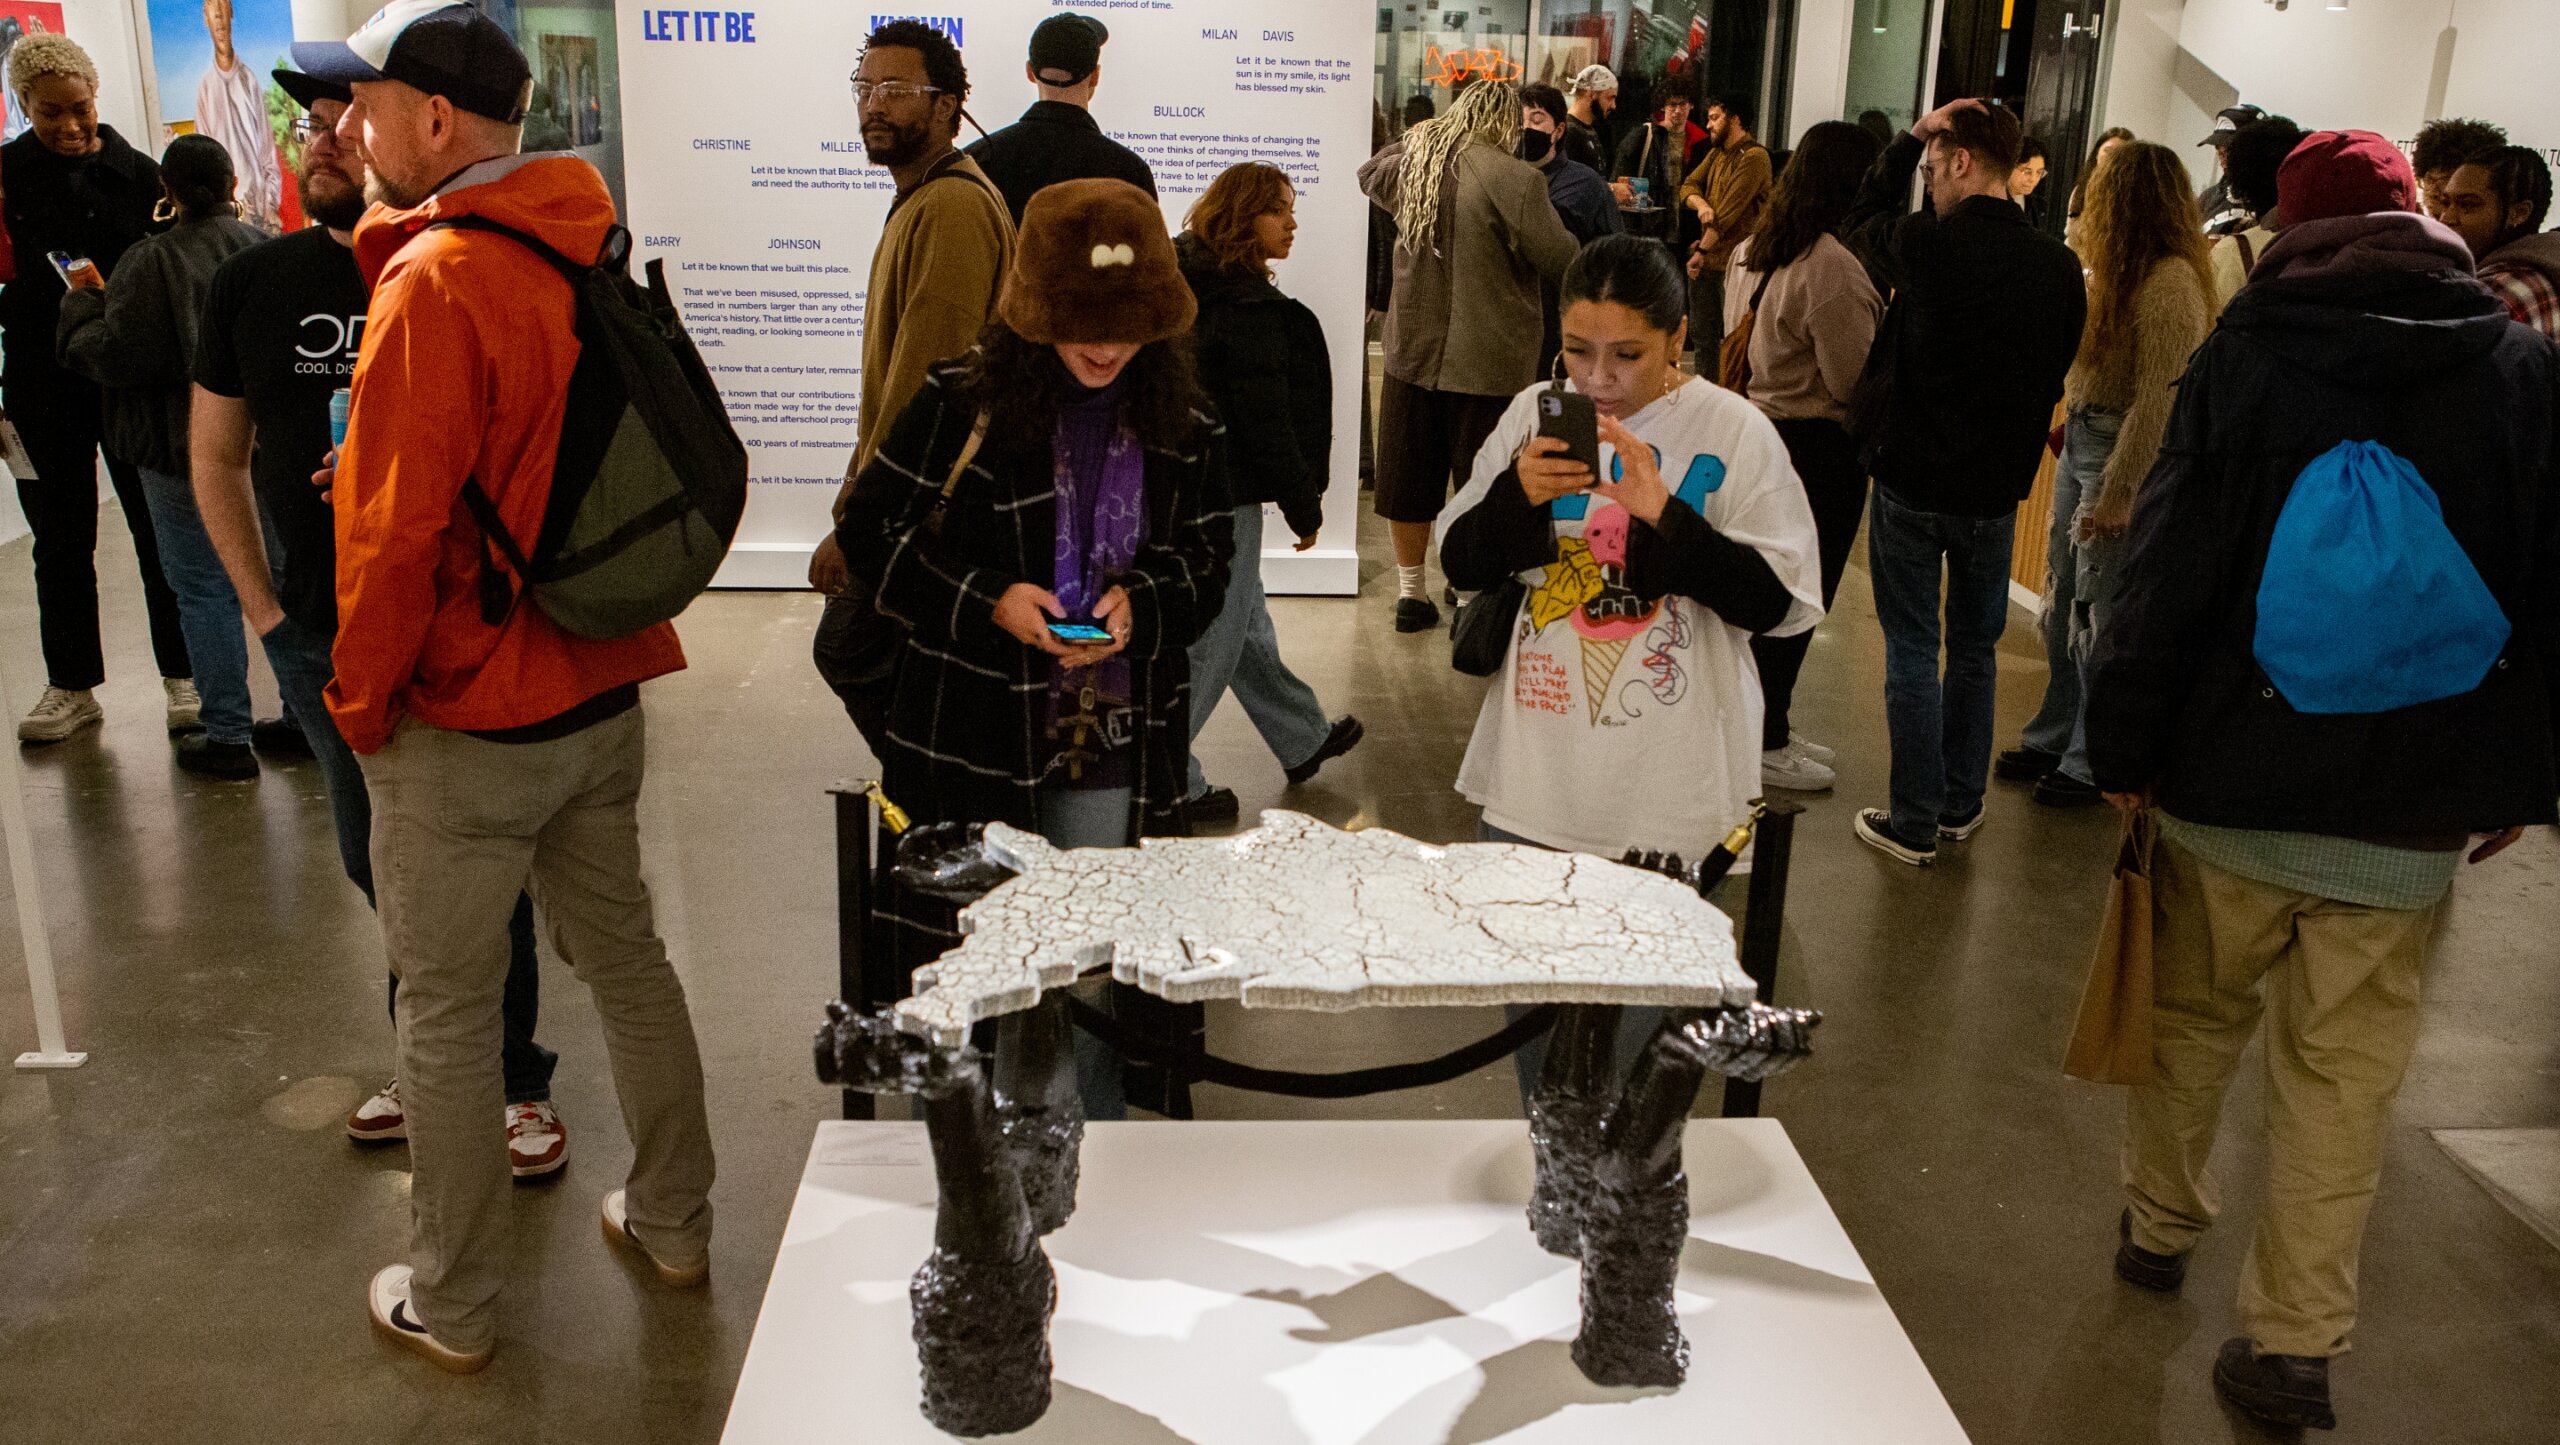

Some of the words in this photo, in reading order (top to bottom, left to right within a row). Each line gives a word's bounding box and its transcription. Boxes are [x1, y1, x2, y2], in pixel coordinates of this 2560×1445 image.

[1109, 0, 1138, 9] period
[1140, 0, 1149, 8] of
[644, 10, 689, 41] LET
[694, 10, 720, 42] IT
[724, 11, 755, 43] BE
[1202, 28, 1237, 40] MILAN
[1262, 30, 1294, 42] DAVIS
[1236, 55, 1250, 64] Let
[1254, 56, 1261, 65] it
[1264, 56, 1276, 65] be
[1280, 57, 1310, 66] known
[1314, 58, 1332, 67] that
[1336, 59, 1351, 68] the
[1254, 69, 1262, 78] is
[1264, 69, 1272, 78] in
[1274, 72, 1288, 80] my
[1318, 71, 1329, 80] its
[1330, 72, 1350, 82] light
[1235, 82, 1251, 91] has
[1253, 82, 1288, 92] blessed
[1289, 85, 1304, 94] my
[1153, 105, 1205, 117] BULLOCK
[1113, 132, 1125, 140] be
[1127, 131, 1157, 140] known
[1159, 132, 1177, 141] that
[1179, 134, 1220, 143] everyone
[1222, 134, 1249, 143] thinks
[1251, 135, 1261, 143] of
[1263, 135, 1303, 146] changing
[1306, 136, 1320, 145] the
[692, 138, 751, 150] CHRISTINE
[820, 141, 861, 152] MILLER
[1166, 145, 1193, 154] thinks
[1196, 146, 1205, 154] of
[1207, 146, 1248, 157] changing
[1305, 149, 1320, 158] We
[1149, 158, 1163, 166] the
[1164, 158, 1183, 167] idea
[1185, 159, 1194, 167] of
[1195, 159, 1235, 169] perfectio
[750, 165, 765, 174] Let
[766, 166, 773, 174] it
[774, 166, 786, 174] be
[787, 166, 817, 175] known
[818, 167, 836, 175] that
[838, 167, 863, 175] Black
[864, 168, 890, 177] peopl
[1161, 171, 1182, 180] have
[1184, 172, 1194, 180] to
[1197, 172, 1208, 181] let
[1302, 175, 1319, 183] and
[751, 179, 768, 187] and
[770, 179, 792, 188] need
[794, 179, 809, 188] the
[810, 180, 850, 190] authority
[851, 181, 861, 189] to
[863, 181, 876, 189] tell
[1157, 184, 1166, 193] to
[1168, 184, 1193, 193] make
[644, 235, 681, 247] BARRY
[767, 238, 820, 250] JOHNSON
[681, 261, 696, 270] Let
[697, 262, 704, 271] it
[705, 262, 717, 271] be
[719, 262, 749, 271] known
[750, 263, 768, 271] that
[785, 263, 805, 272] built
[806, 264, 823, 272] this
[682, 287, 703, 296] That
[734, 288, 757, 297] been
[854, 291, 866, 299] sil
[683, 300, 714, 309] erased
[716, 300, 725, 309] in
[728, 301, 767, 310] numbers
[770, 302, 796, 312] larger
[798, 302, 818, 311] than
[821, 304, 837, 312] any
[840, 303, 863, 311] other
[762, 314, 782, 323] That
[783, 314, 802, 323] little
[770, 327, 802, 337] looking
[295, 362, 331, 374] COOL
[335, 363, 354, 374] DIS
[718, 363, 743, 373] know
[744, 364, 762, 373] that
[770, 365, 804, 375] century
[727, 388, 757, 397] known
[760, 389, 778, 398] that
[798, 390, 855, 399] contributions
[724, 401, 751, 410] cation
[753, 402, 779, 410] made
[781, 404, 799, 412] way
[802, 402, 814, 411] for
[817, 403, 831, 411] the
[834, 403, 857, 411] devel
[761, 414, 778, 422] and
[779, 414, 828, 423] afterschool
[745, 439, 761, 447] 400
[763, 440, 787, 448] years
[789, 439, 798, 447] of
[761, 475, 772, 484] let
[774, 475, 780, 484] it
[781, 475, 793, 484] be
[794, 476, 823, 484] known
[825, 476, 842, 485] that
